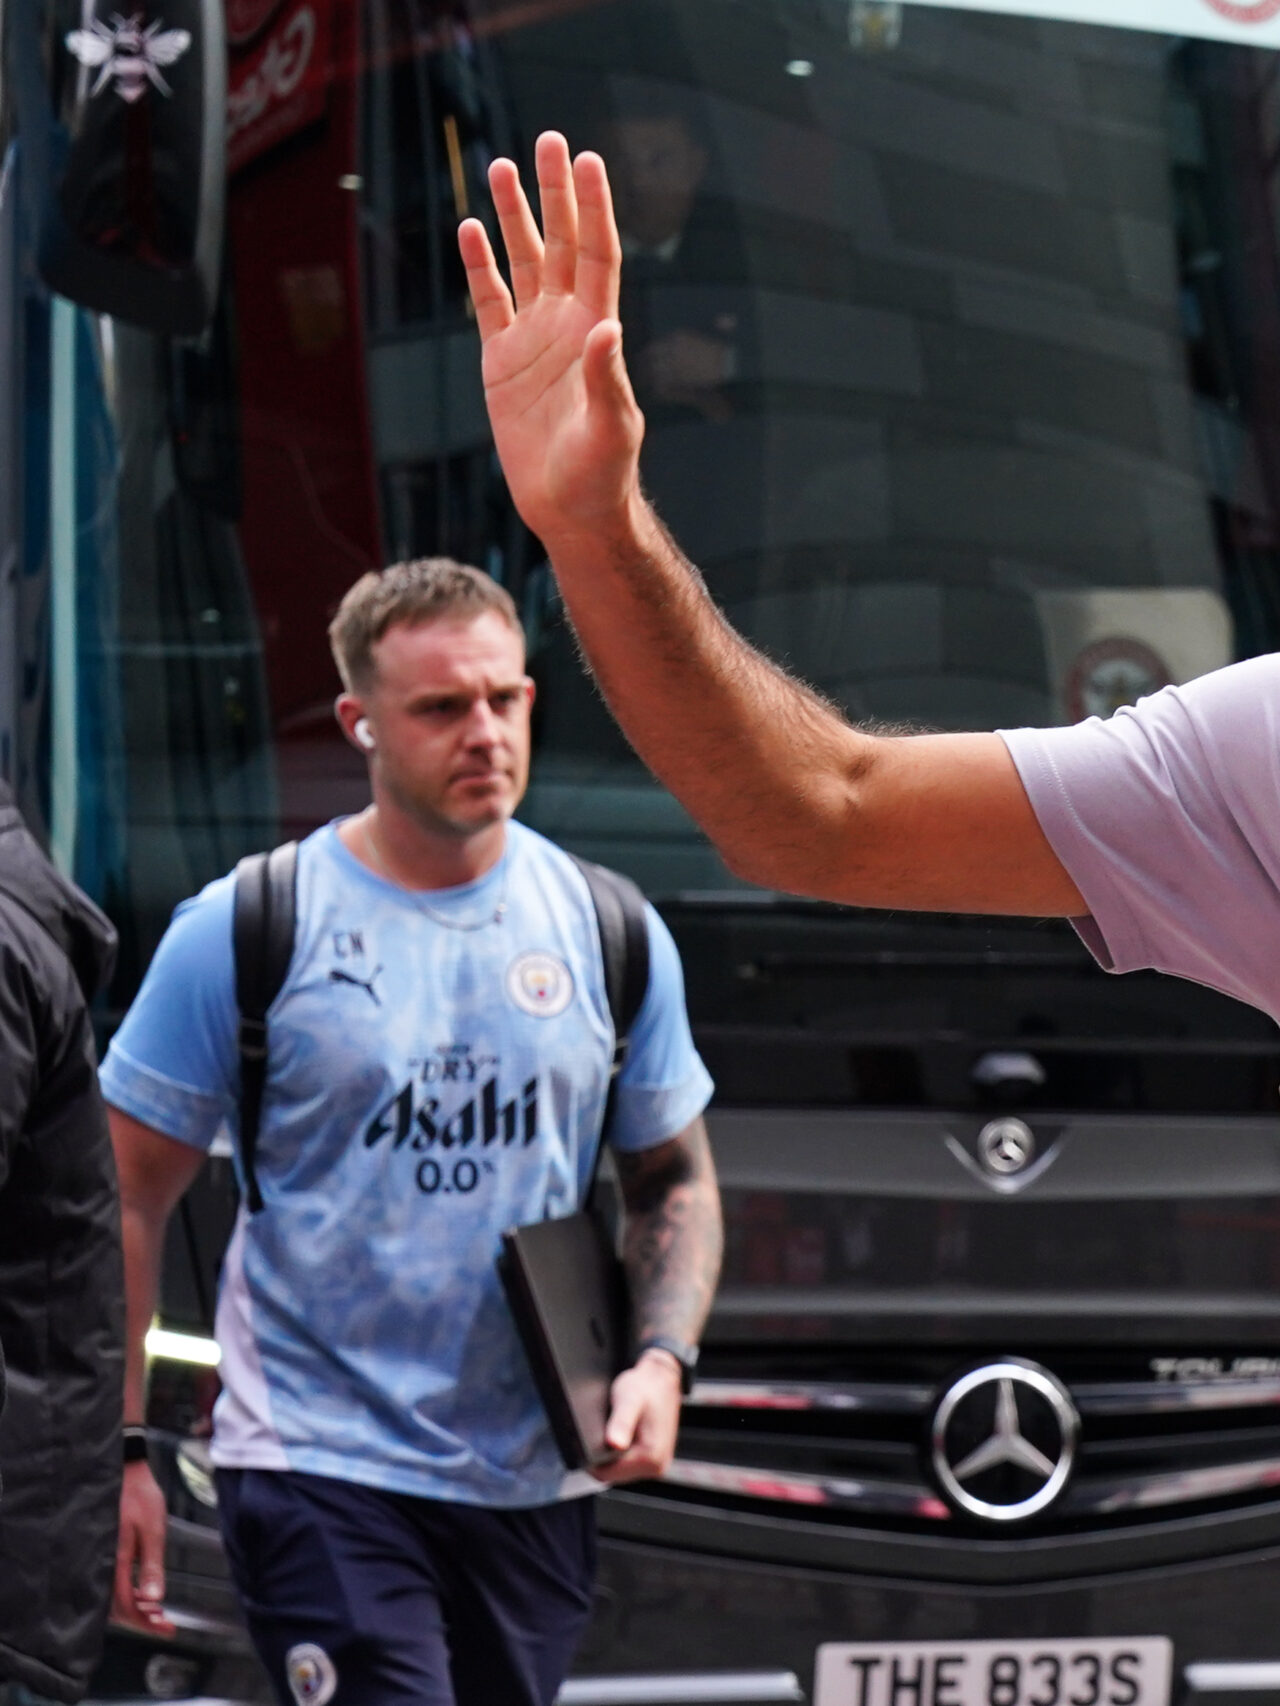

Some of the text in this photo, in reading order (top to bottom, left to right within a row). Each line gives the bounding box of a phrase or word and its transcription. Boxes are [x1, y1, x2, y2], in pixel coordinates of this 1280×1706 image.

[364, 1074, 539, 1151] Asahi
[849, 1652, 1142, 1706] THE 833S
